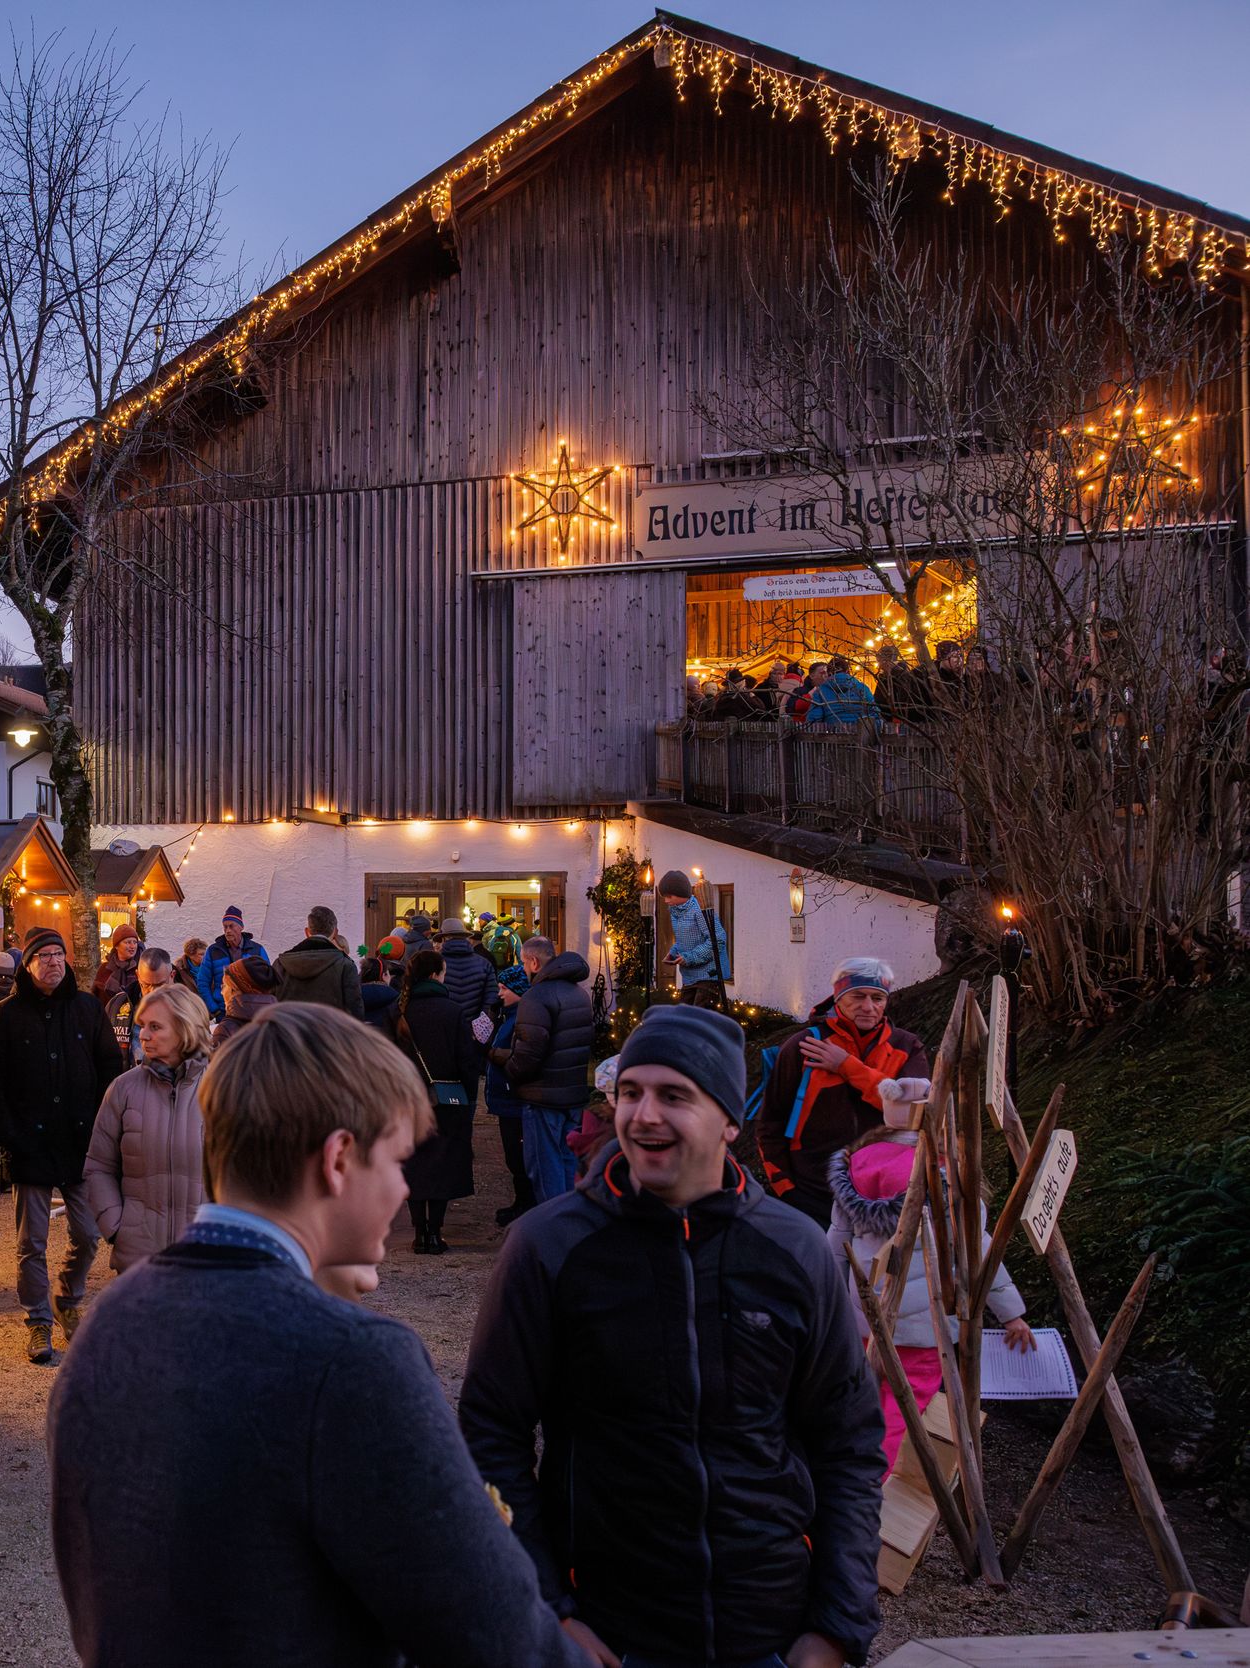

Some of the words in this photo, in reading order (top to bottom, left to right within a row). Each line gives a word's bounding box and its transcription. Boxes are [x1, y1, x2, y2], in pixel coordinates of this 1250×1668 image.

[647, 500, 757, 541] Advent
[778, 499, 819, 532] im
[1032, 1213, 1047, 1239] Da
